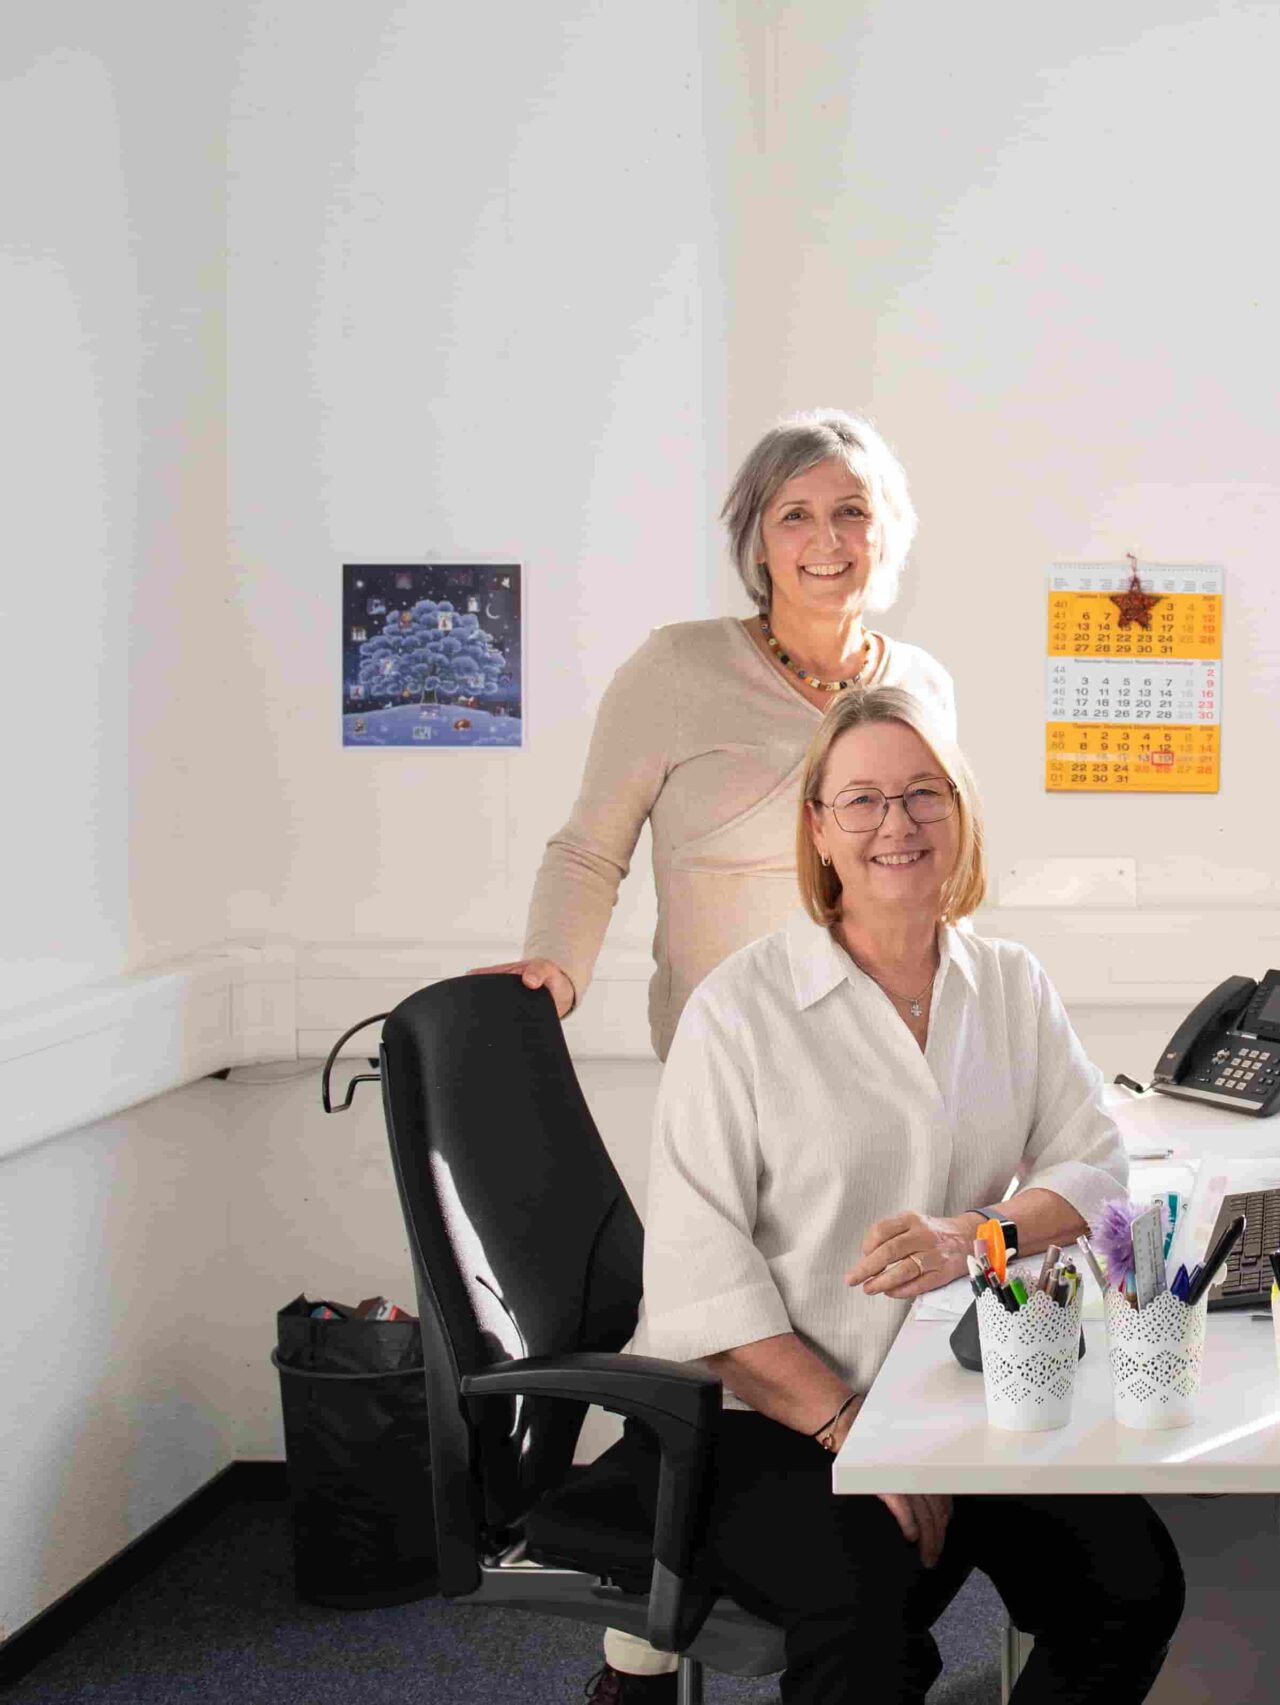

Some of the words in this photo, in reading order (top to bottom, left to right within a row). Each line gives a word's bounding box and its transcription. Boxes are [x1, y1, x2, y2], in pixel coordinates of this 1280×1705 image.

[1166, 603, 1174, 611] 3
[1082, 612, 1090, 620] 6
[1161, 614, 1174, 622] 10
[1077, 623, 1090, 631] 13
[1098, 623, 1111, 631] 14
[1162, 624, 1174, 633] 17
[1203, 625, 1215, 633] 19
[1097, 634, 1111, 642] 21
[1116, 634, 1131, 642] 22
[1137, 634, 1153, 642] 23
[1157, 635, 1173, 643] 24
[1075, 644, 1089, 652] 27
[1095, 645, 1111, 653] 28
[1116, 645, 1131, 653] 29
[1137, 645, 1152, 653] 30
[1160, 646, 1173, 654] 31
[1207, 668, 1215, 677] 2
[1052, 677, 1066, 685] 45
[1082, 677, 1089, 685] 3
[1123, 678, 1130, 686] 5
[1166, 679, 1172, 687] 7
[1207, 680, 1214, 688] 9
[1076, 688, 1089, 696] 10
[1139, 689, 1151, 697] 13
[1160, 690, 1172, 698] 14
[1201, 690, 1213, 698] 16
[1097, 699, 1109, 707] 18
[1118, 699, 1130, 707] 19
[1135, 700, 1151, 708] 20
[1159, 700, 1172, 708] 21
[1198, 701, 1214, 709] 23
[1072, 709, 1088, 717] 24
[1093, 710, 1109, 718] 25
[1114, 710, 1130, 718] 26
[1156, 711, 1172, 719] 28
[1101, 732, 1109, 740] 2
[1143, 733, 1150, 741] 4
[1164, 733, 1172, 741] 5
[1206, 734, 1213, 742] 7
[1101, 743, 1108, 751] 9
[1116, 743, 1130, 751] 10
[1159, 744, 1171, 752] 12
[1201, 745, 1213, 753] 14
[1072, 764, 1087, 772] 22
[1093, 764, 1108, 772] 23
[1113, 764, 1129, 772] 24
[1196, 766, 1212, 774] 28
[1092, 775, 1108, 783] 30
[1116, 775, 1129, 783] 31
